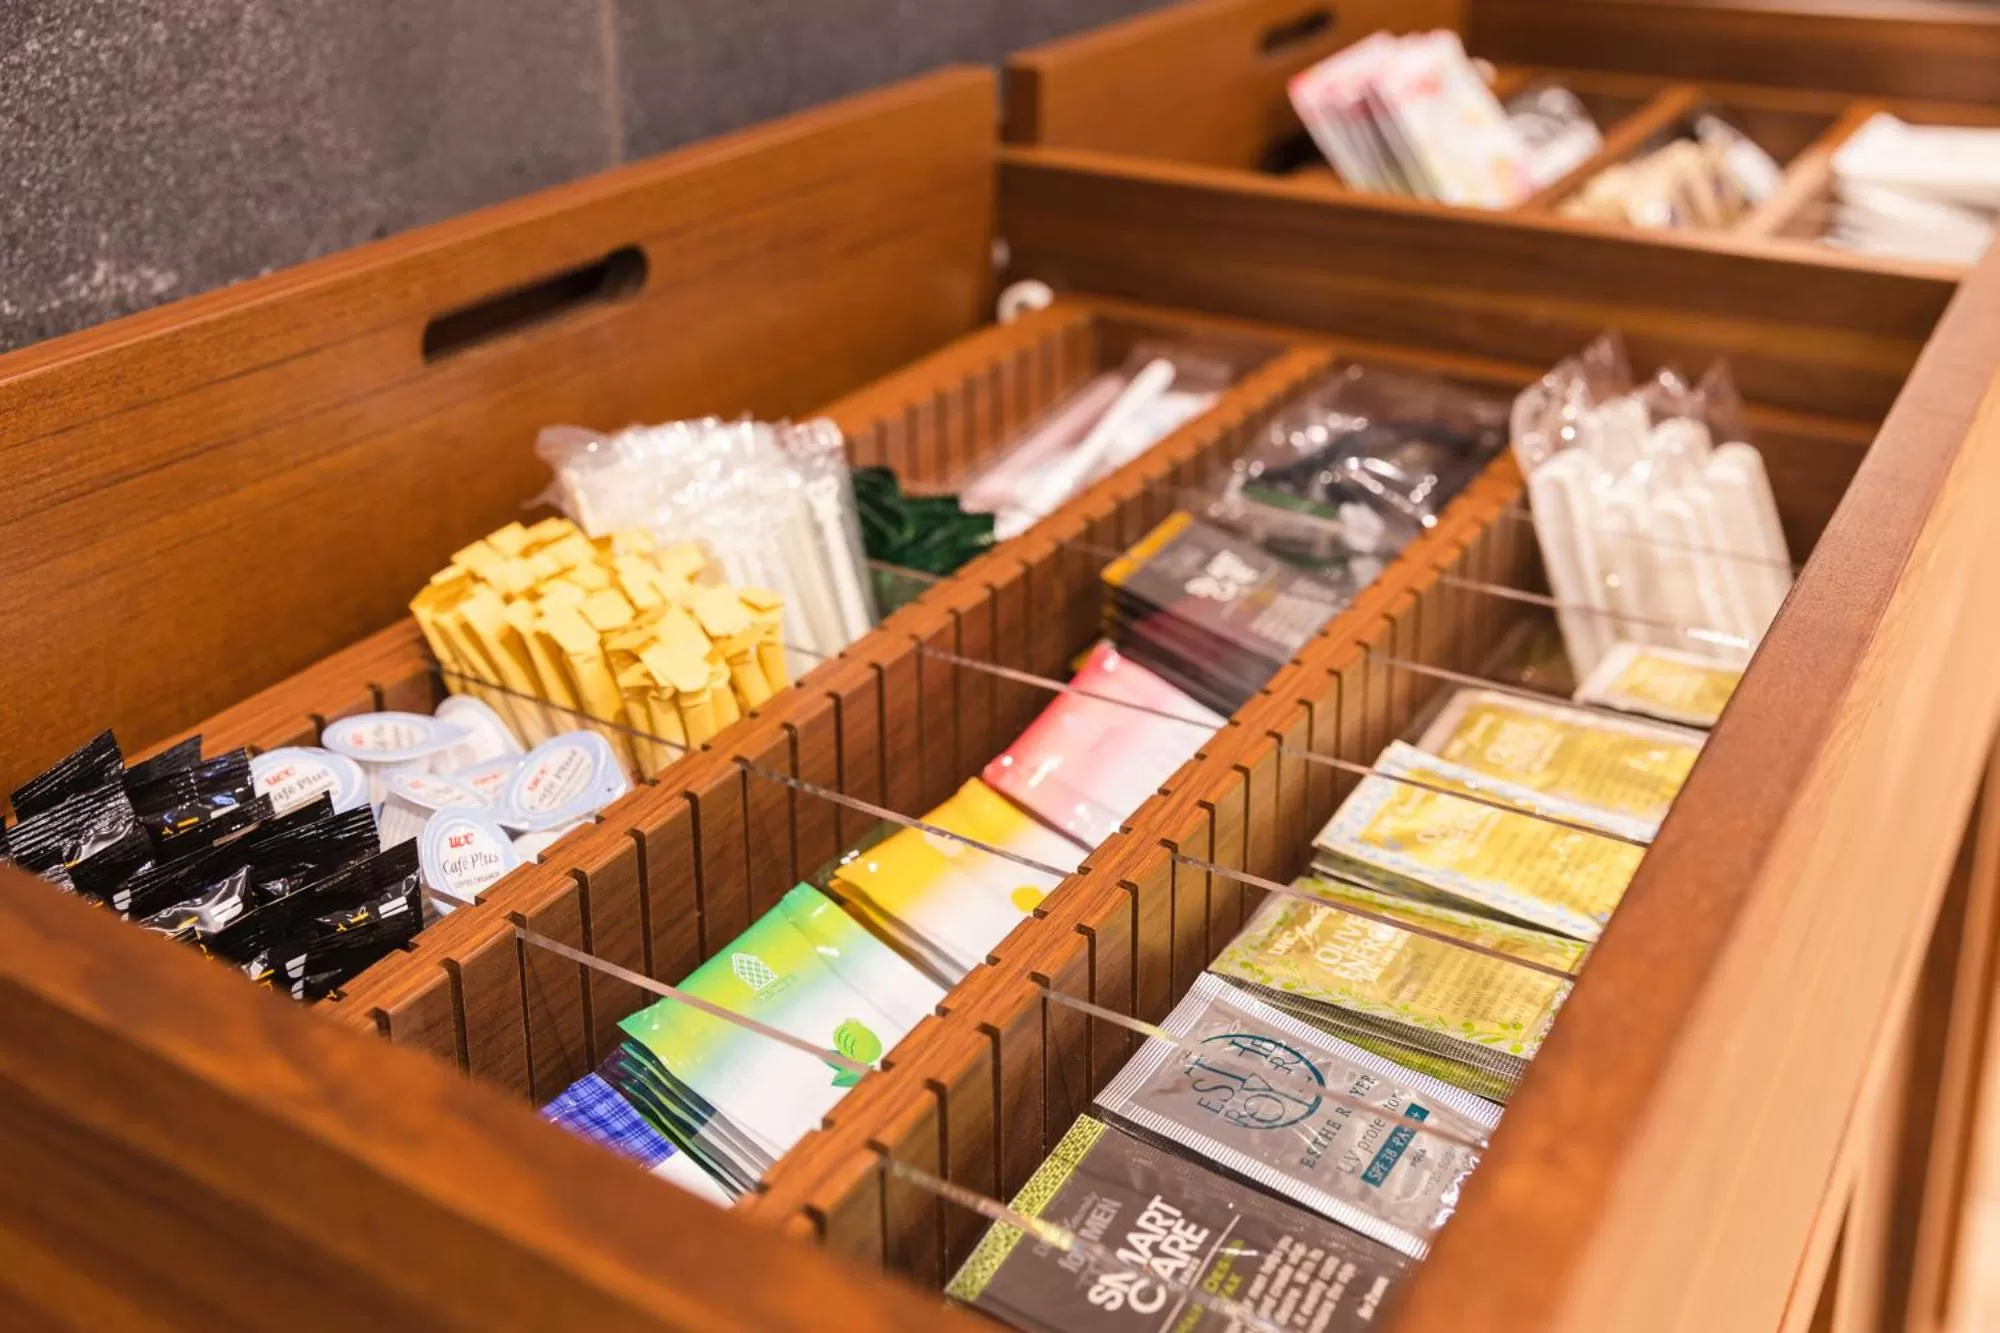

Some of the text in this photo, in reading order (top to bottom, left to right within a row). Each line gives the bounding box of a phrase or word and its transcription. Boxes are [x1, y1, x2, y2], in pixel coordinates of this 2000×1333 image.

[273, 784, 297, 802] afé
[443, 852, 499, 878] Café Plus
[1335, 1073, 1377, 1119] RYER
[1357, 1092, 1401, 1155] protetor
[1368, 1158, 1386, 1182] SPF
[1382, 1147, 1399, 1162] 38
[1079, 1198, 1123, 1242] MEN
[1087, 1194, 1183, 1312] SMART
[1127, 1217, 1210, 1315] CARE
